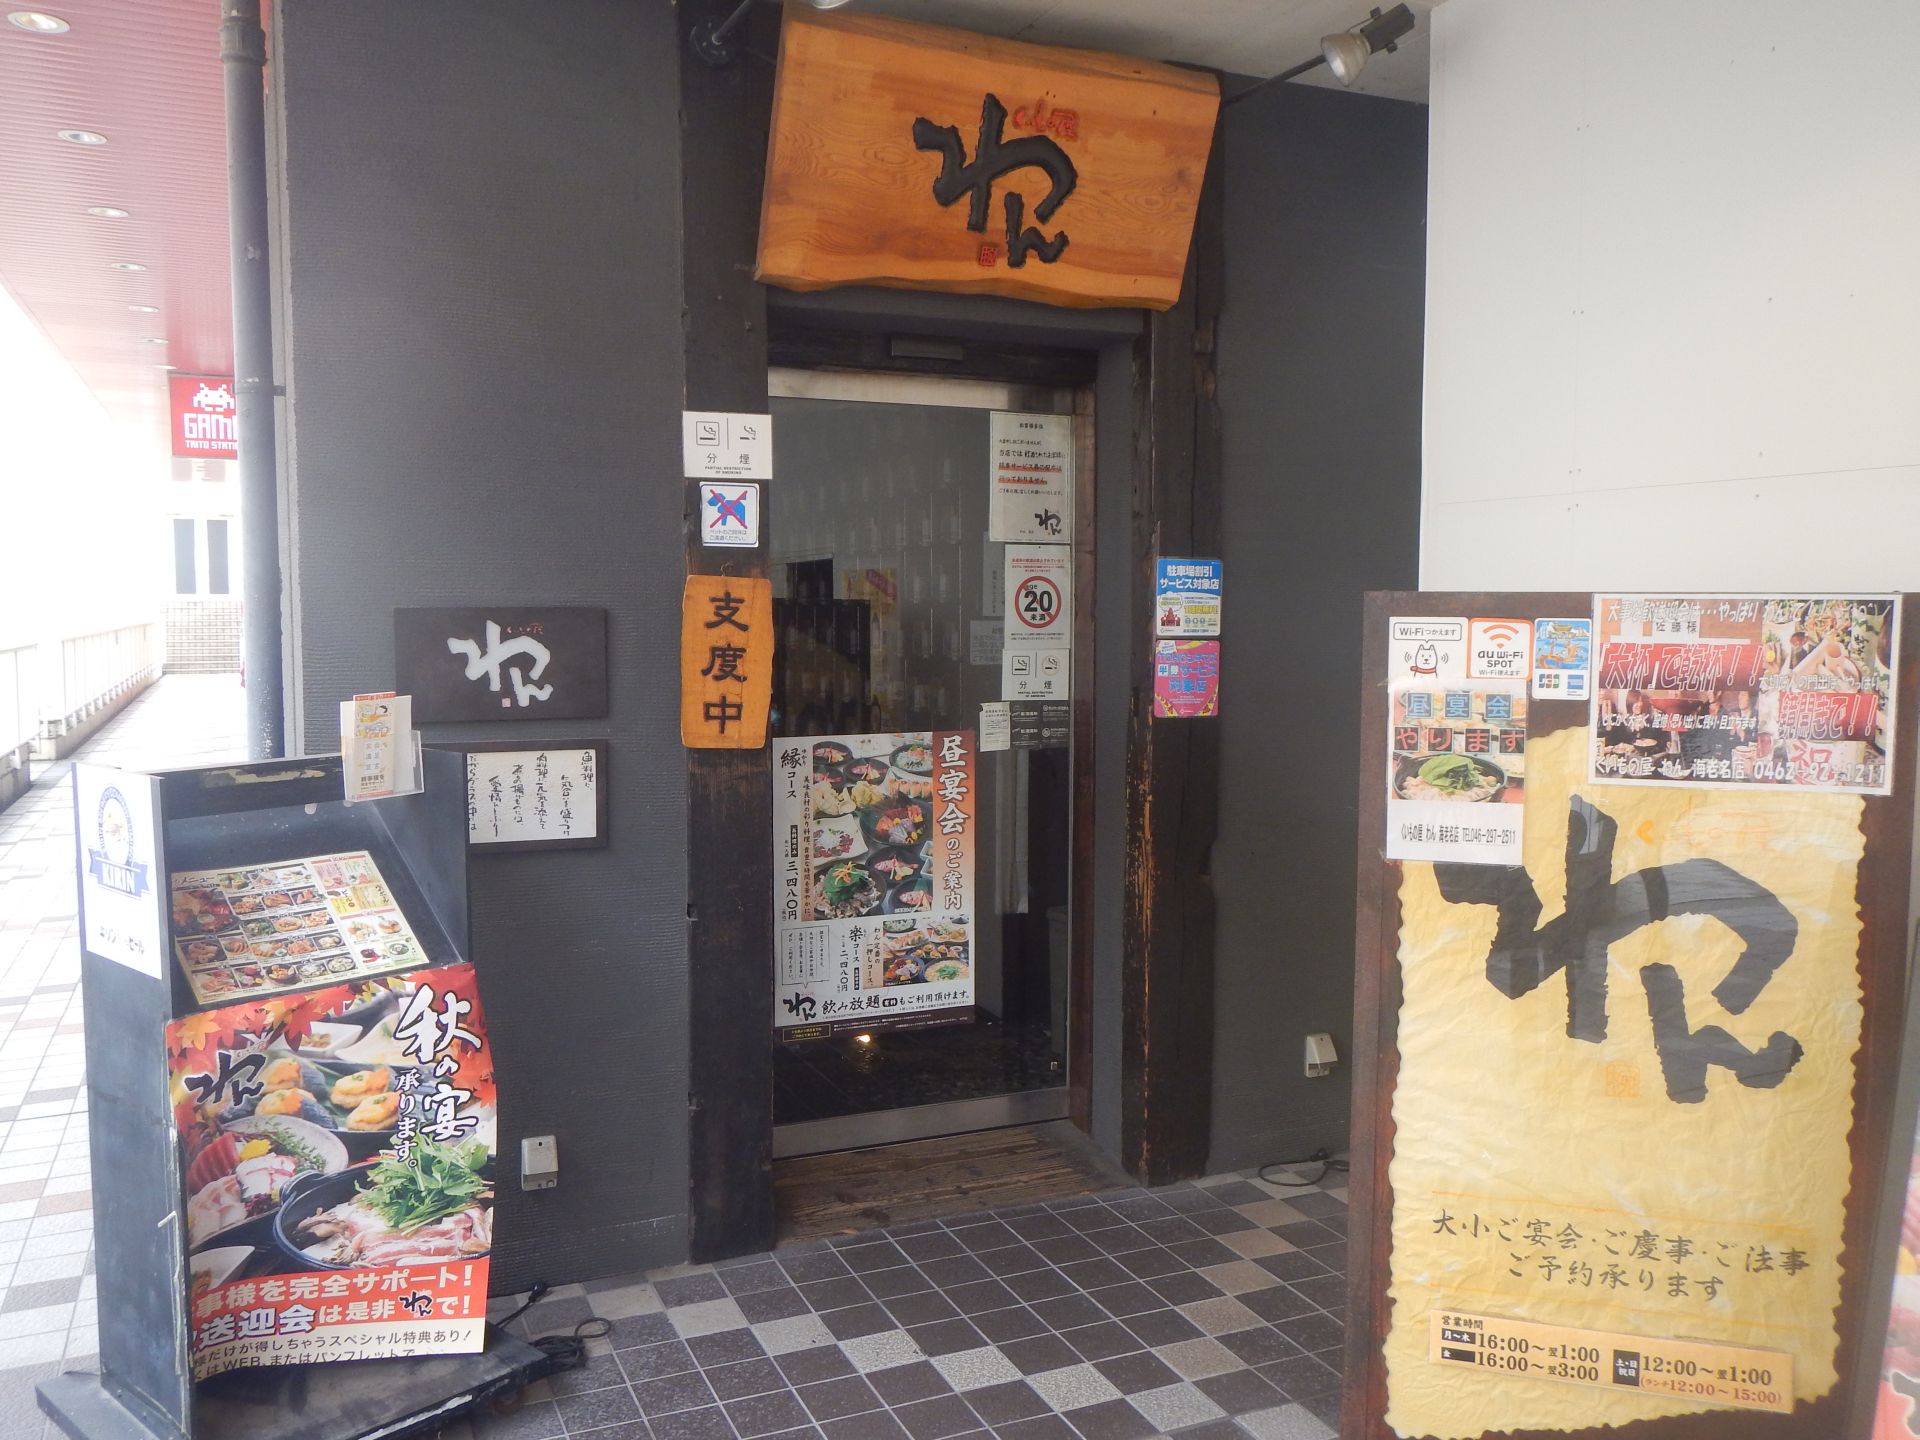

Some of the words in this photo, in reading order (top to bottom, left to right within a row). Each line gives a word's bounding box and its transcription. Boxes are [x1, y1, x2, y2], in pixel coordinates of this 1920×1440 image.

[912, 93, 1078, 269] わん
[185, 440, 209, 449] TAITO
[707, 452, 717, 463] 分
[1035, 509, 1061, 535] わん
[1160, 577, 1220, 590] サービス対象店
[1167, 565, 1213, 577] 駐車場割引
[1024, 590, 1053, 613] 20
[447, 620, 553, 707] わん
[701, 592, 749, 735] 支度中
[1478, 651, 1494, 659] au
[1487, 660, 1513, 668] SPOT
[1019, 680, 1027, 690] 分
[1409, 694, 1510, 717] 昼宴会
[1397, 727, 1524, 752] やります
[937, 734, 970, 911] 昼宴会のご案内
[1426, 824, 1436, 841] わん
[102, 862, 135, 892] KIRIN
[849, 925, 863, 962] 楽コース
[873, 927, 881, 964] わん定番の
[1433, 794, 1804, 1104] わん
[784, 992, 816, 1021] わん
[822, 994, 880, 1014] 飲み放題
[393, 984, 482, 1142] 秋の宴
[184, 1051, 267, 1107] わん
[394, 1068, 421, 1168] 承ります。
[1508, 1252, 1725, 1300] ご予約承ります
[1441, 1315, 1484, 1330] 営業時間
